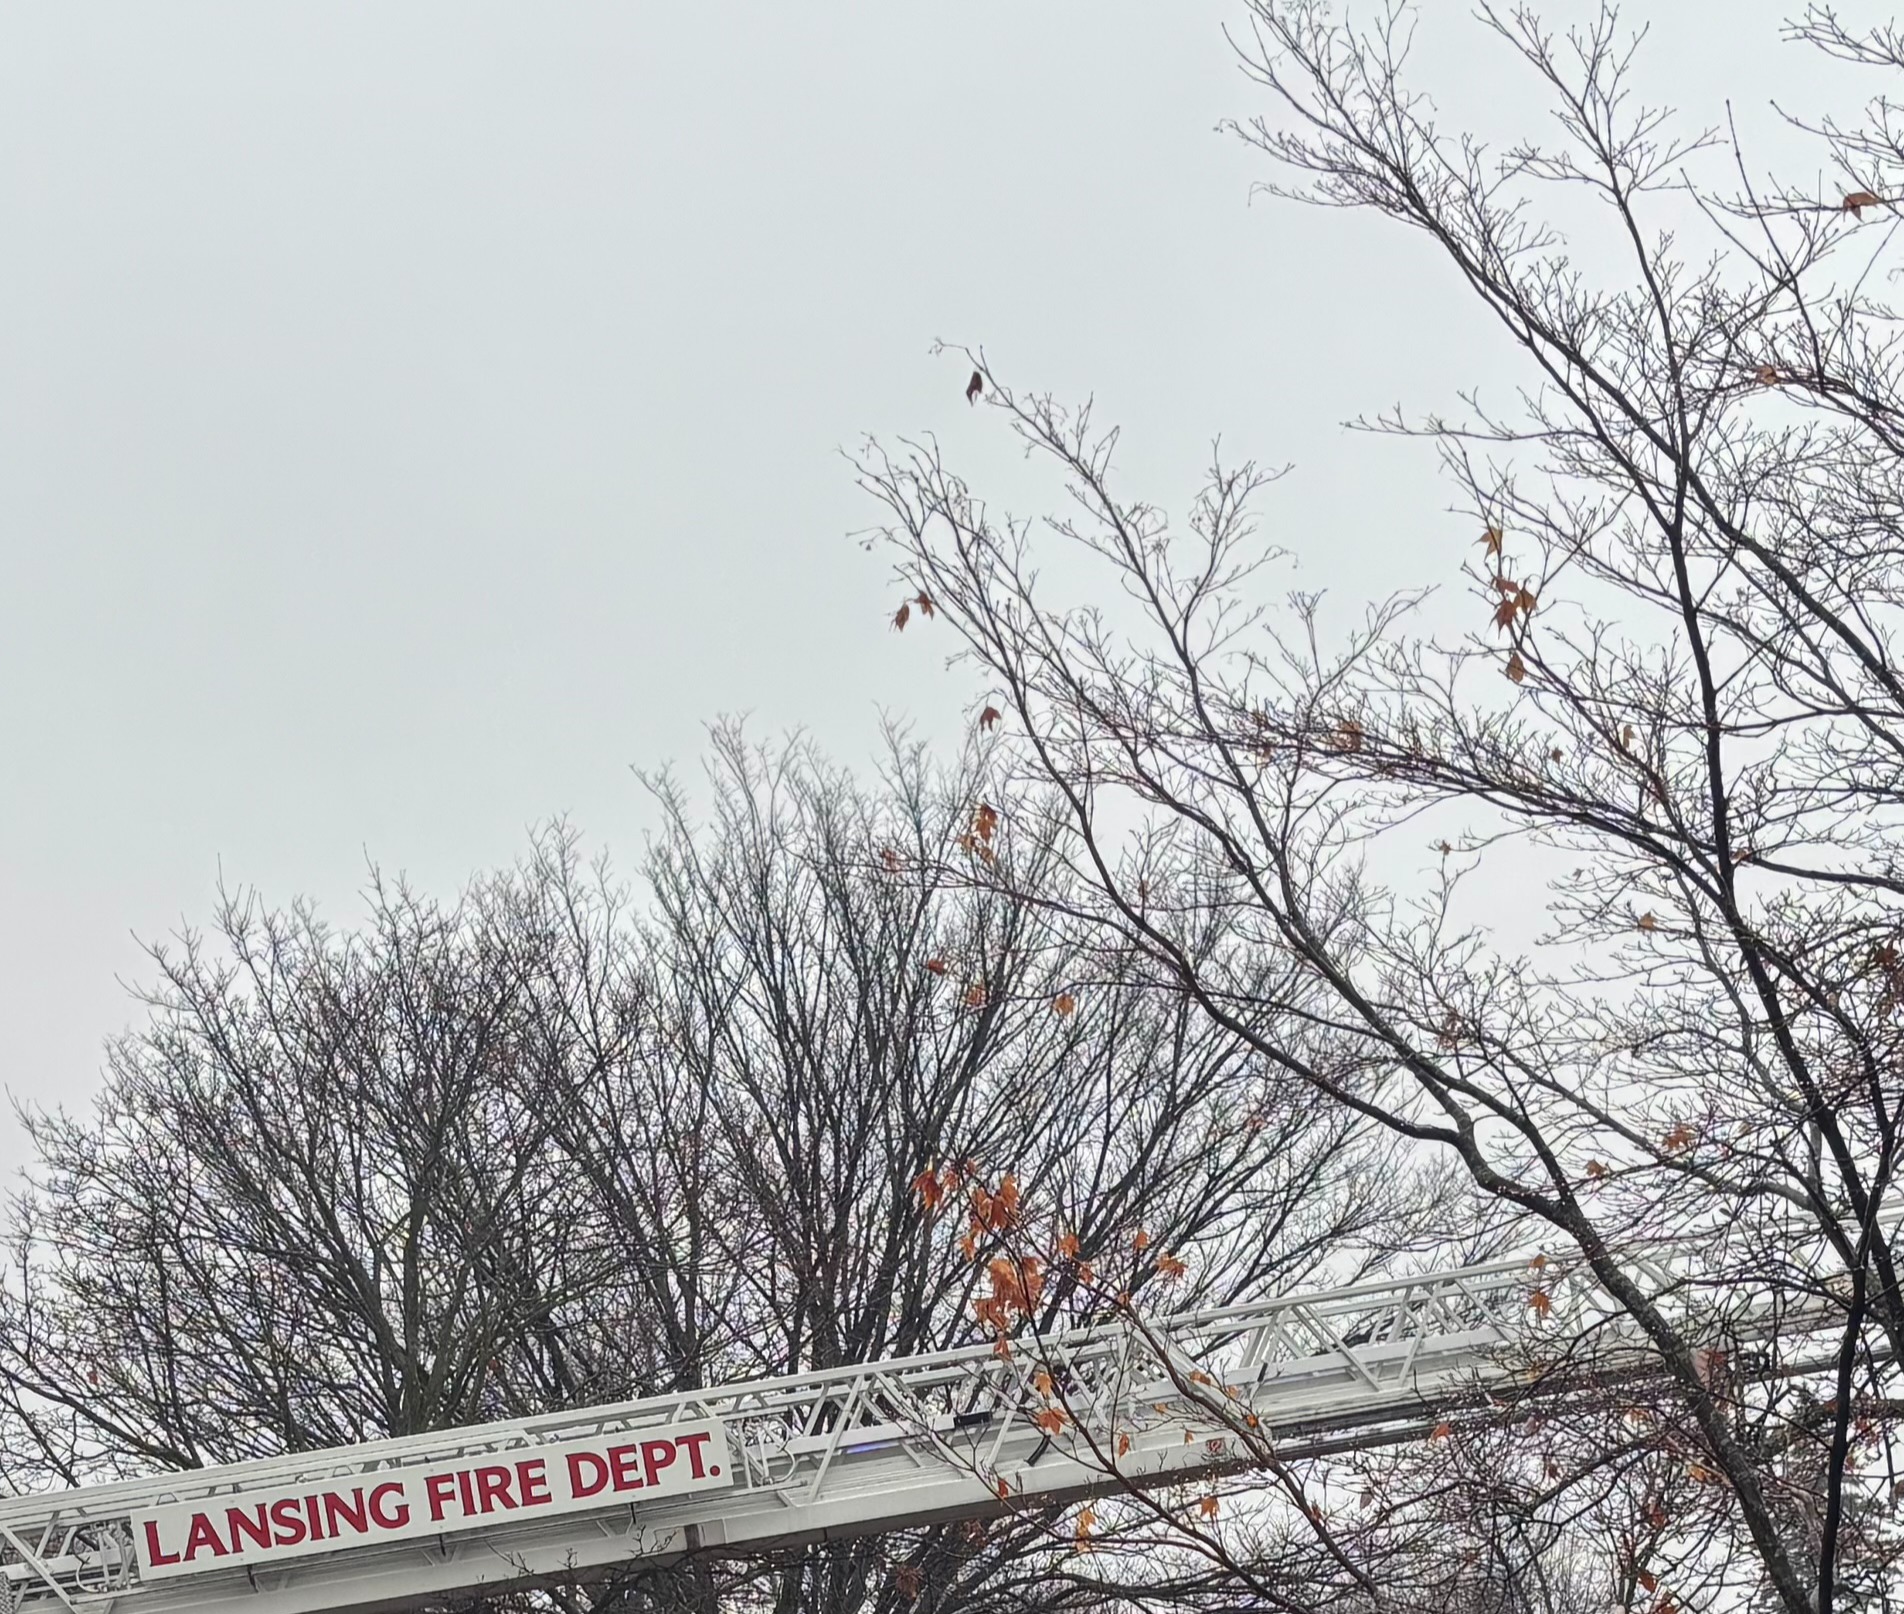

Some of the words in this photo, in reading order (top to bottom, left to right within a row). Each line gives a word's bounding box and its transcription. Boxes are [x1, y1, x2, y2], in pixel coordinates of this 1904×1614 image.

[146, 1481, 411, 1568] LANSING
[424, 1458, 552, 1522] FIRE
[565, 1432, 721, 1500] DEPT.
